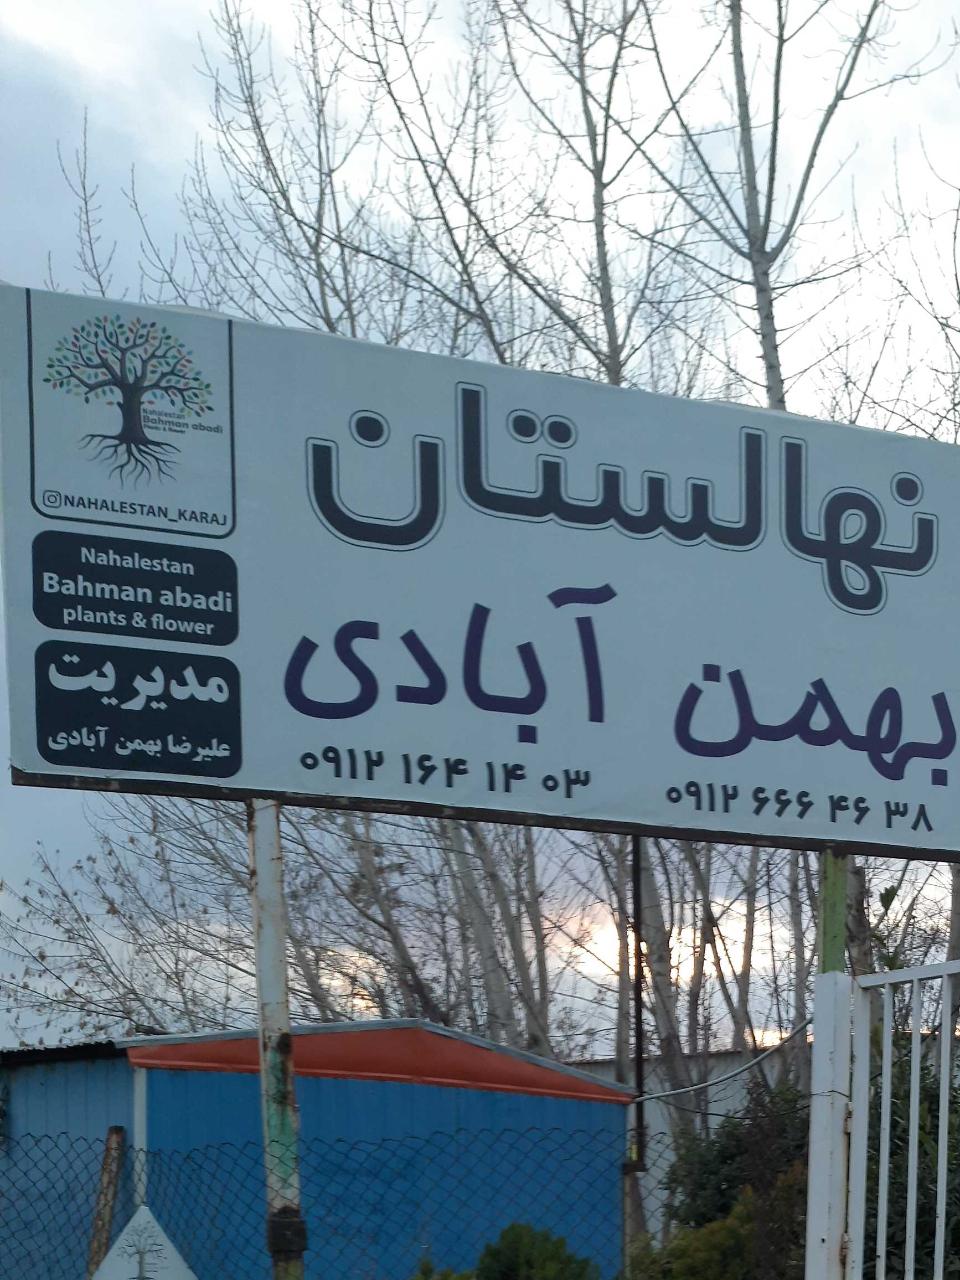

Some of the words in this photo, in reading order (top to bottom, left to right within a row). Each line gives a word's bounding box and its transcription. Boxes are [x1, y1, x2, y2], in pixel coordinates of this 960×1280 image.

[143, 415, 189, 429] Bahman
[191, 422, 223, 434] abadi
[63, 494, 228, 526] NAHALESTAN_KARAJ
[306, 381, 938, 616] نهالستان
[80, 546, 195, 576] Nahalestan
[43, 572, 152, 604] Bahman
[159, 586, 233, 613] abadi
[63, 605, 126, 625] plants
[132, 612, 147, 628] &
[151, 614, 215, 636] flower
[284, 583, 618, 744] آبادی
[48, 653, 230, 711] مدیریت
[47, 725, 109, 752] آبادی
[674, 663, 957, 786] بهمن
[114, 736, 162, 758] بهمن
[167, 734, 231, 762] علیرضا
[299, 745, 384, 781] ۰۹۱۲
[401, 753, 470, 788] ۱۶۴
[486, 761, 527, 793] ۱۴
[541, 768, 591, 799] ۰۳
[666, 780, 739, 814] ۰۹۱۲
[752, 786, 814, 819] ۶۶۶
[828, 794, 871, 825] ۴۶
[884, 800, 933, 832] ۳۸
